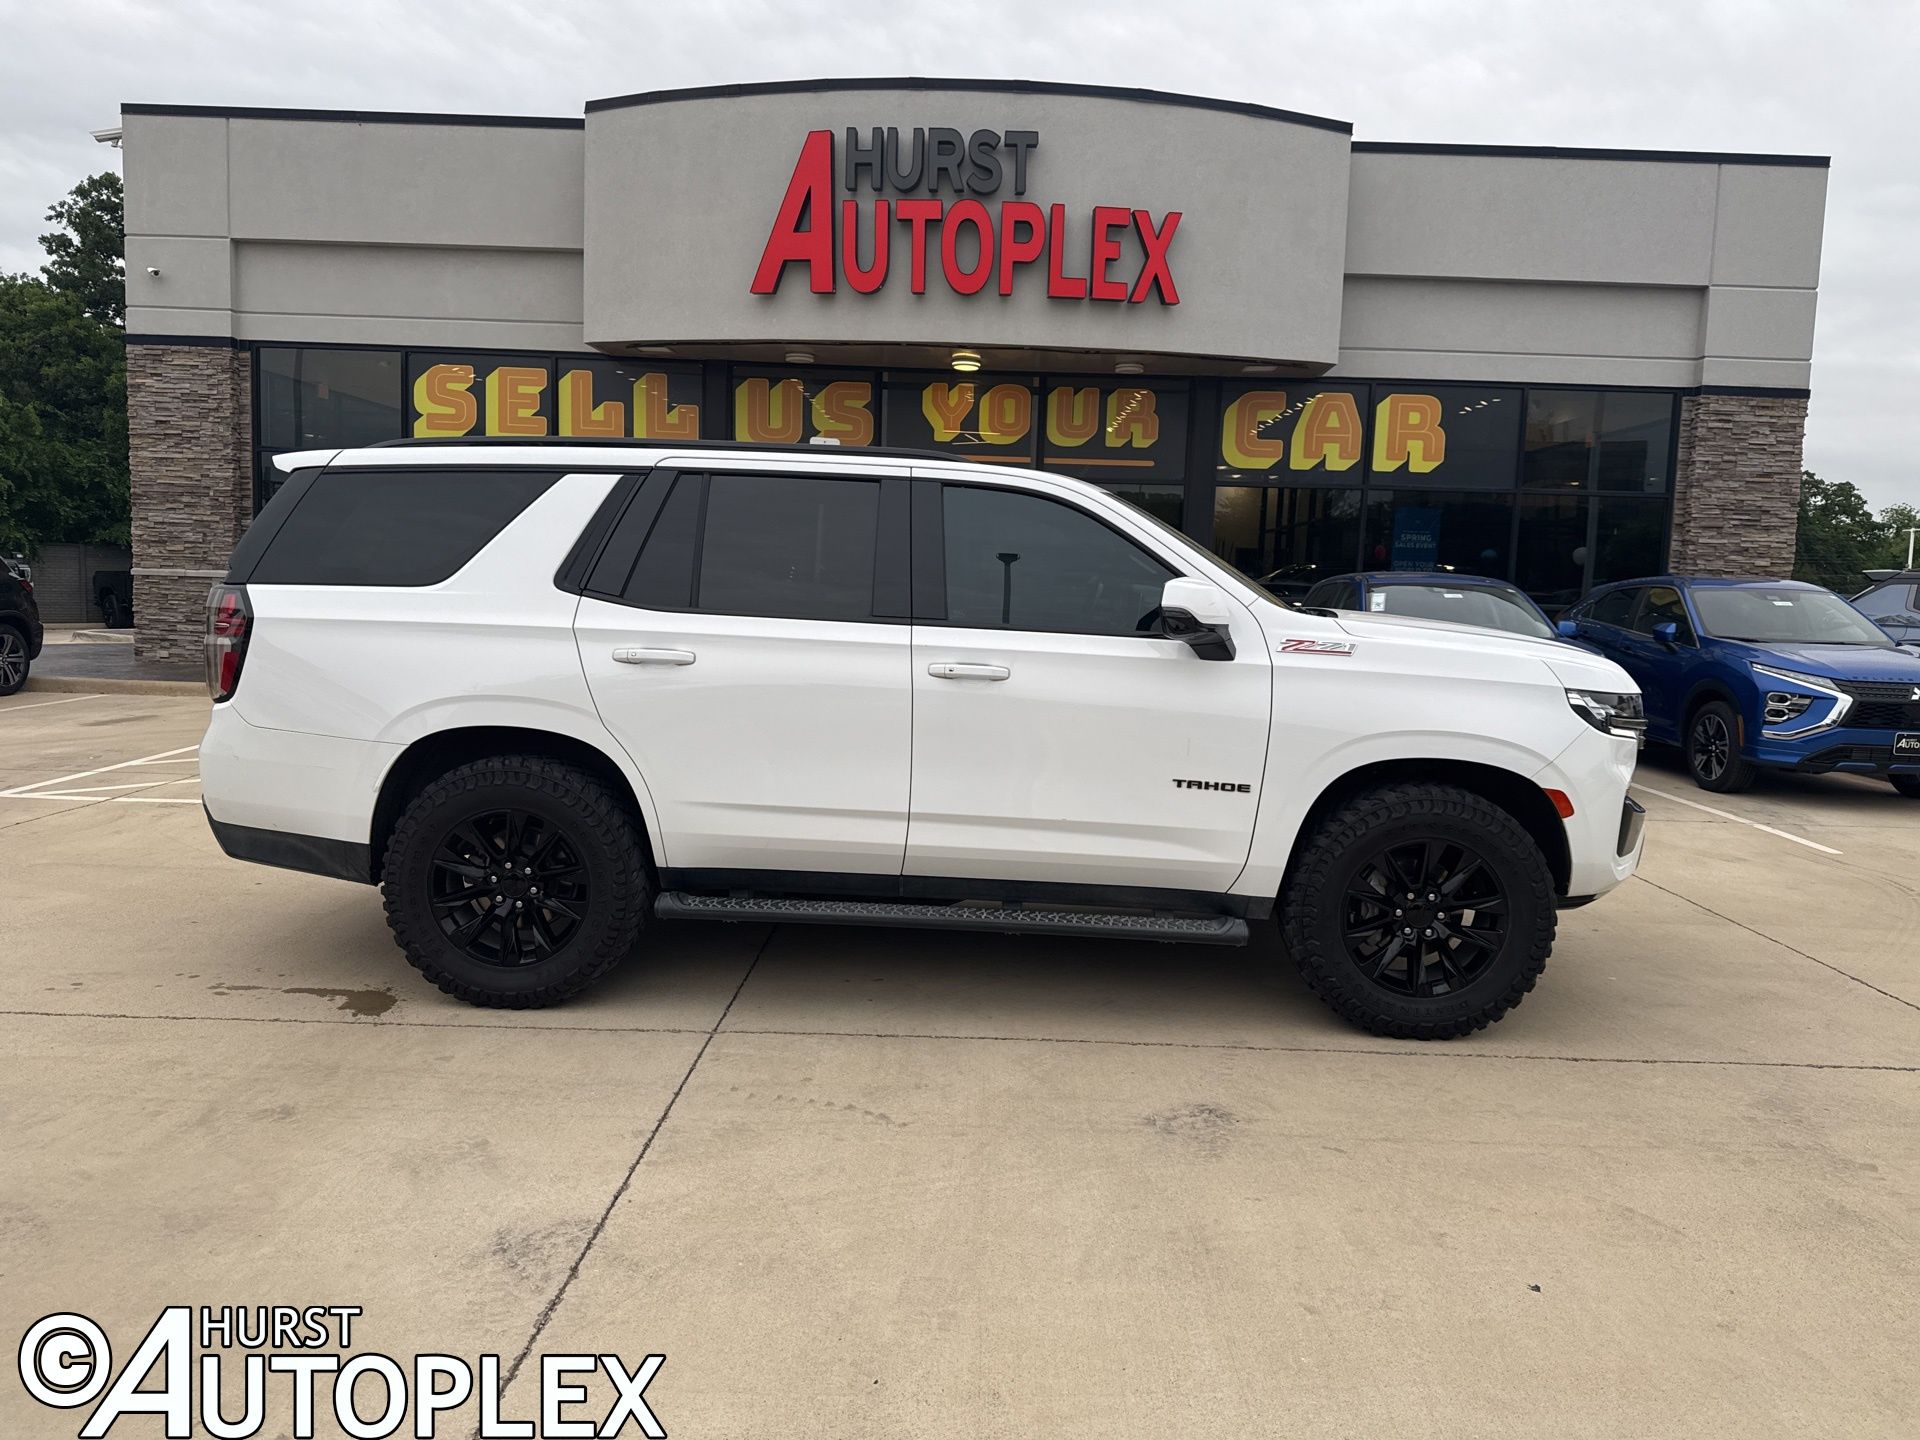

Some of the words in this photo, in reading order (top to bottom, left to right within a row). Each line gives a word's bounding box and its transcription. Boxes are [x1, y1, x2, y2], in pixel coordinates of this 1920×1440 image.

[845, 127, 1039, 195] HURST
[750, 129, 1183, 305] AUTOPLEX
[413, 364, 700, 440] SELL
[735, 377, 875, 446] US
[922, 382, 1160, 448] YOUR
[1222, 390, 1446, 474] CAR
[1400, 533, 1432, 542] SPRING
[1276, 638, 1358, 656] Z71
[1172, 778, 1251, 793] TAHOE
